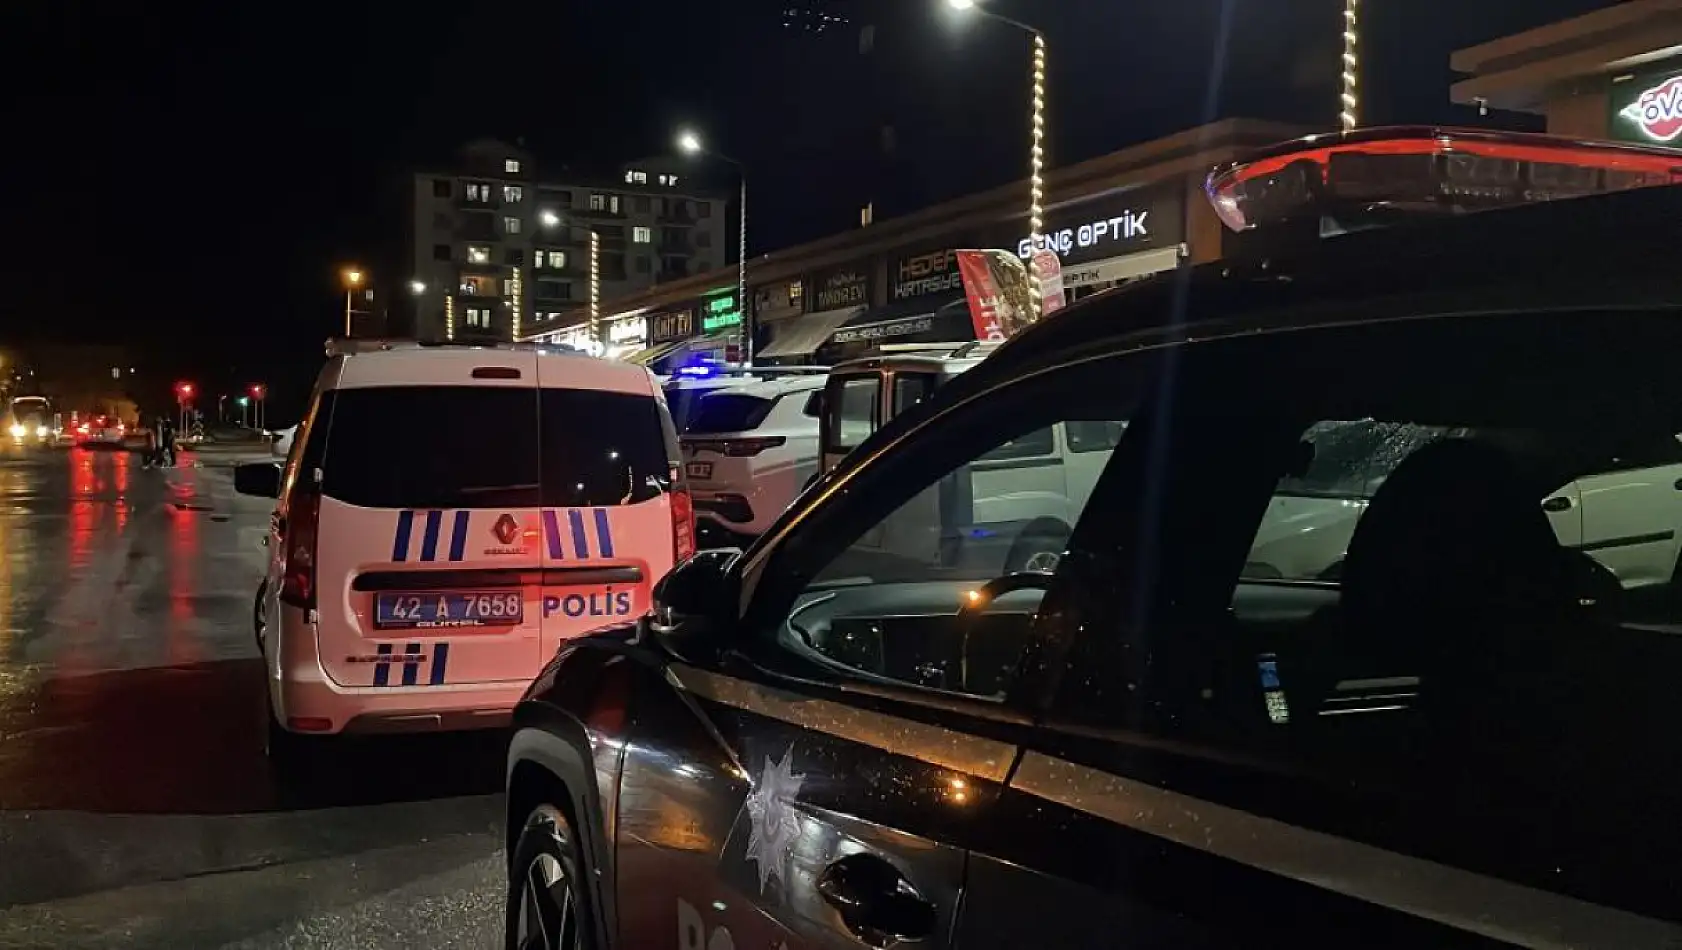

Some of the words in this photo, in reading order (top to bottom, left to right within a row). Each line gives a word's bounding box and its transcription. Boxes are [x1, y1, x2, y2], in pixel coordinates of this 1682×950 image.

[1077, 209, 1148, 247] OPTİK
[392, 597, 421, 619] 42
[436, 595, 449, 618] A
[463, 595, 519, 617] 7658
[543, 586, 631, 618] POLİS
